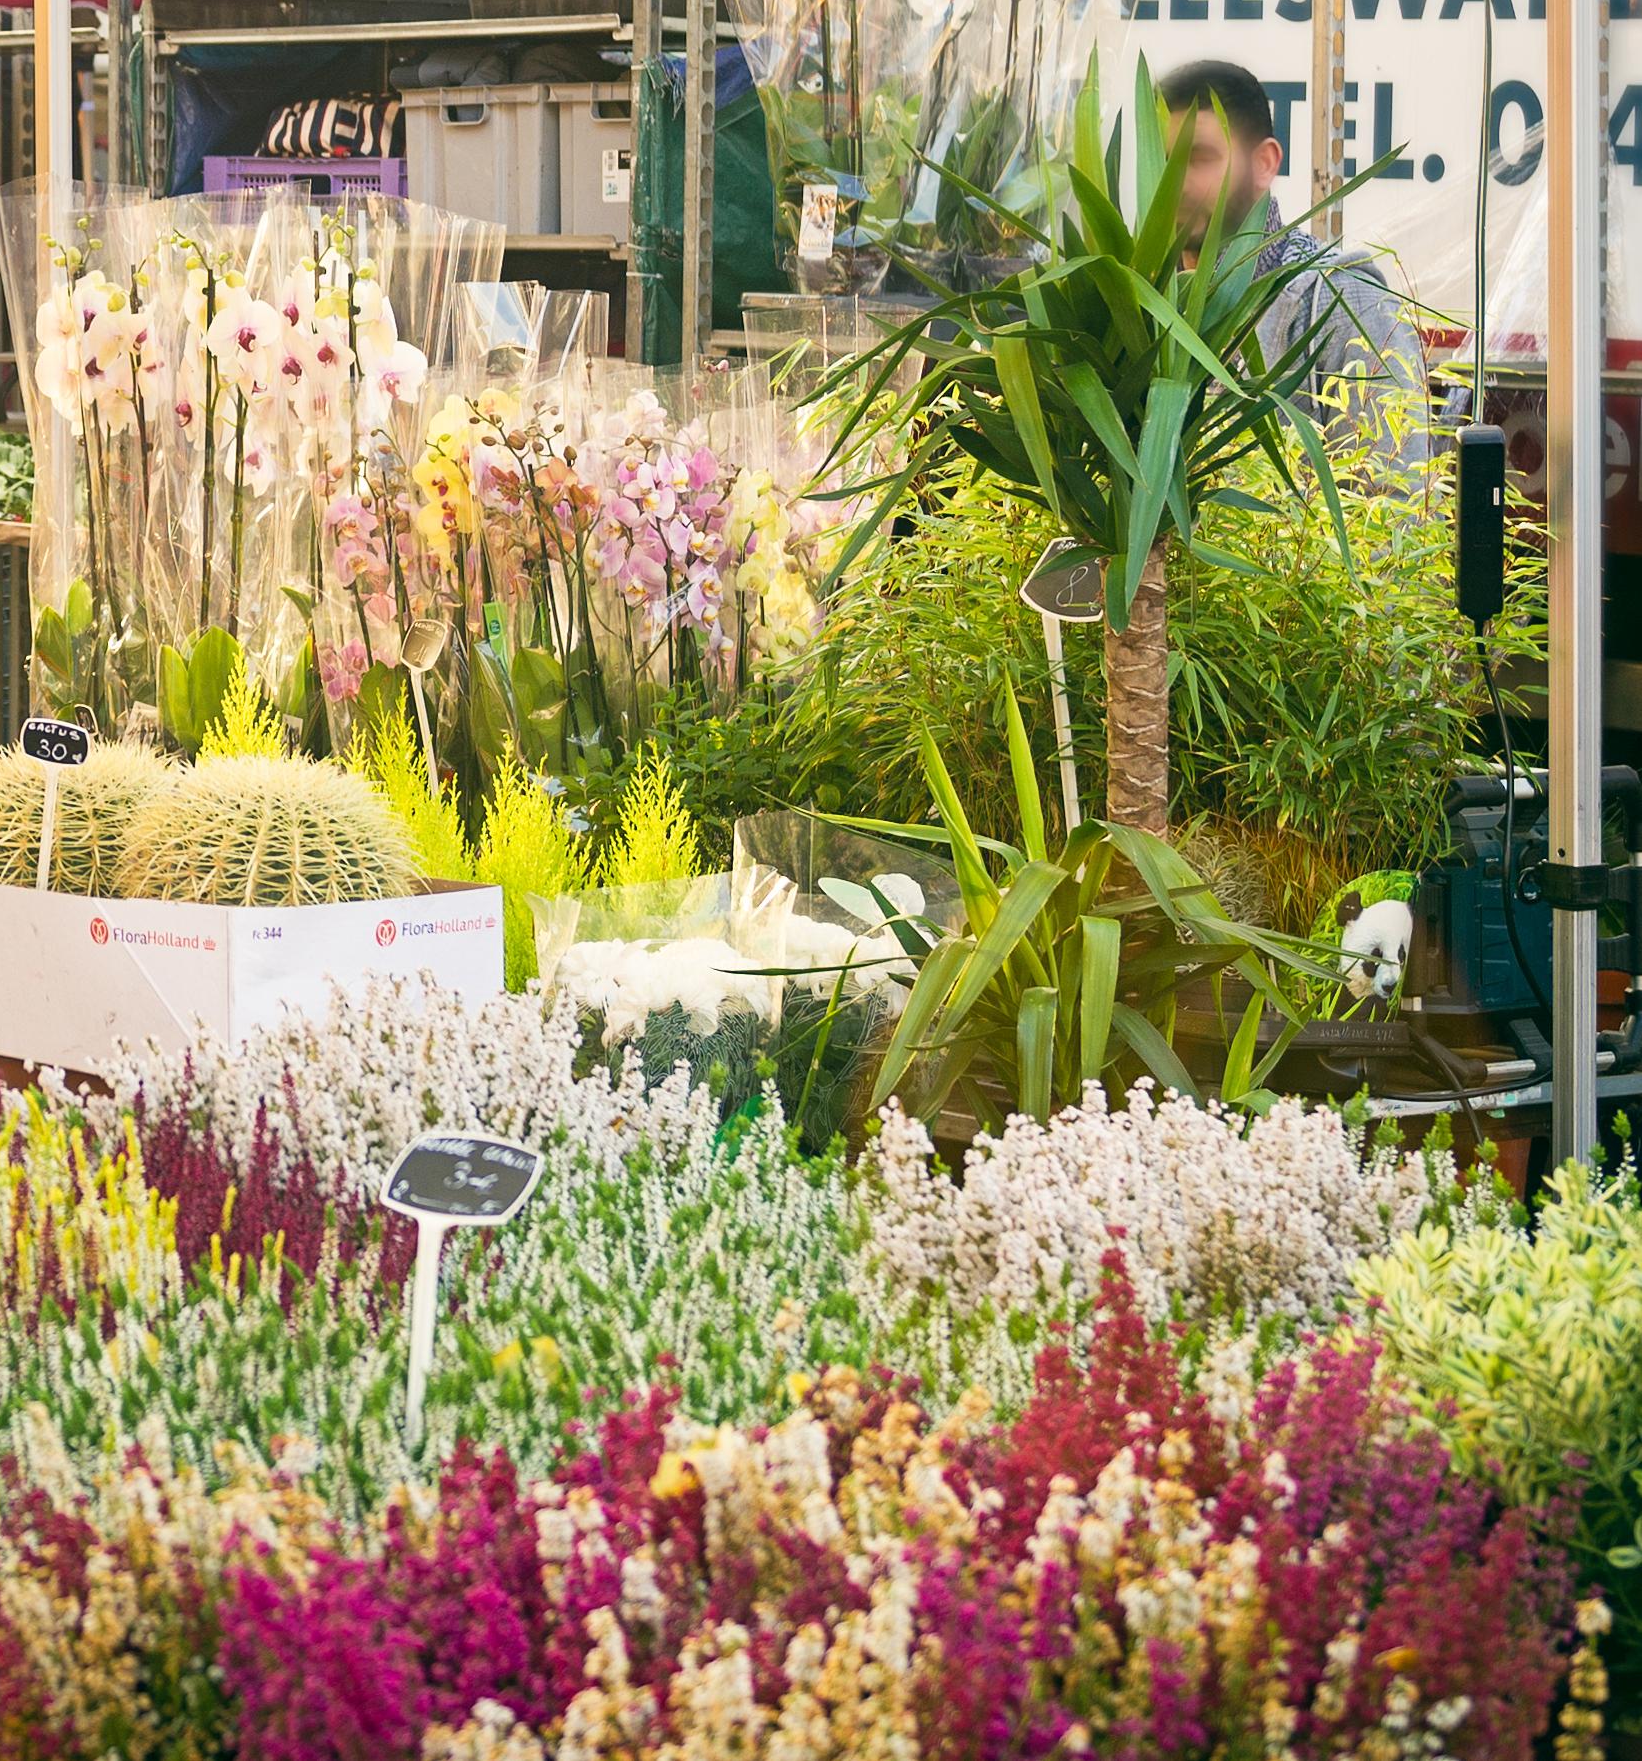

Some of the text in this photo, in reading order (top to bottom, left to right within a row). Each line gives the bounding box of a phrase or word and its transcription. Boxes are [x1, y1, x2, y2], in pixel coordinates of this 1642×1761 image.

[1055, 565, 1089, 608] 8
[28, 722, 81, 741] CACTUS
[36, 738, 68, 761] 30
[262, 926, 282, 940] 344
[401, 915, 483, 937] FloraHolland
[112, 926, 200, 950] FloraHolland
